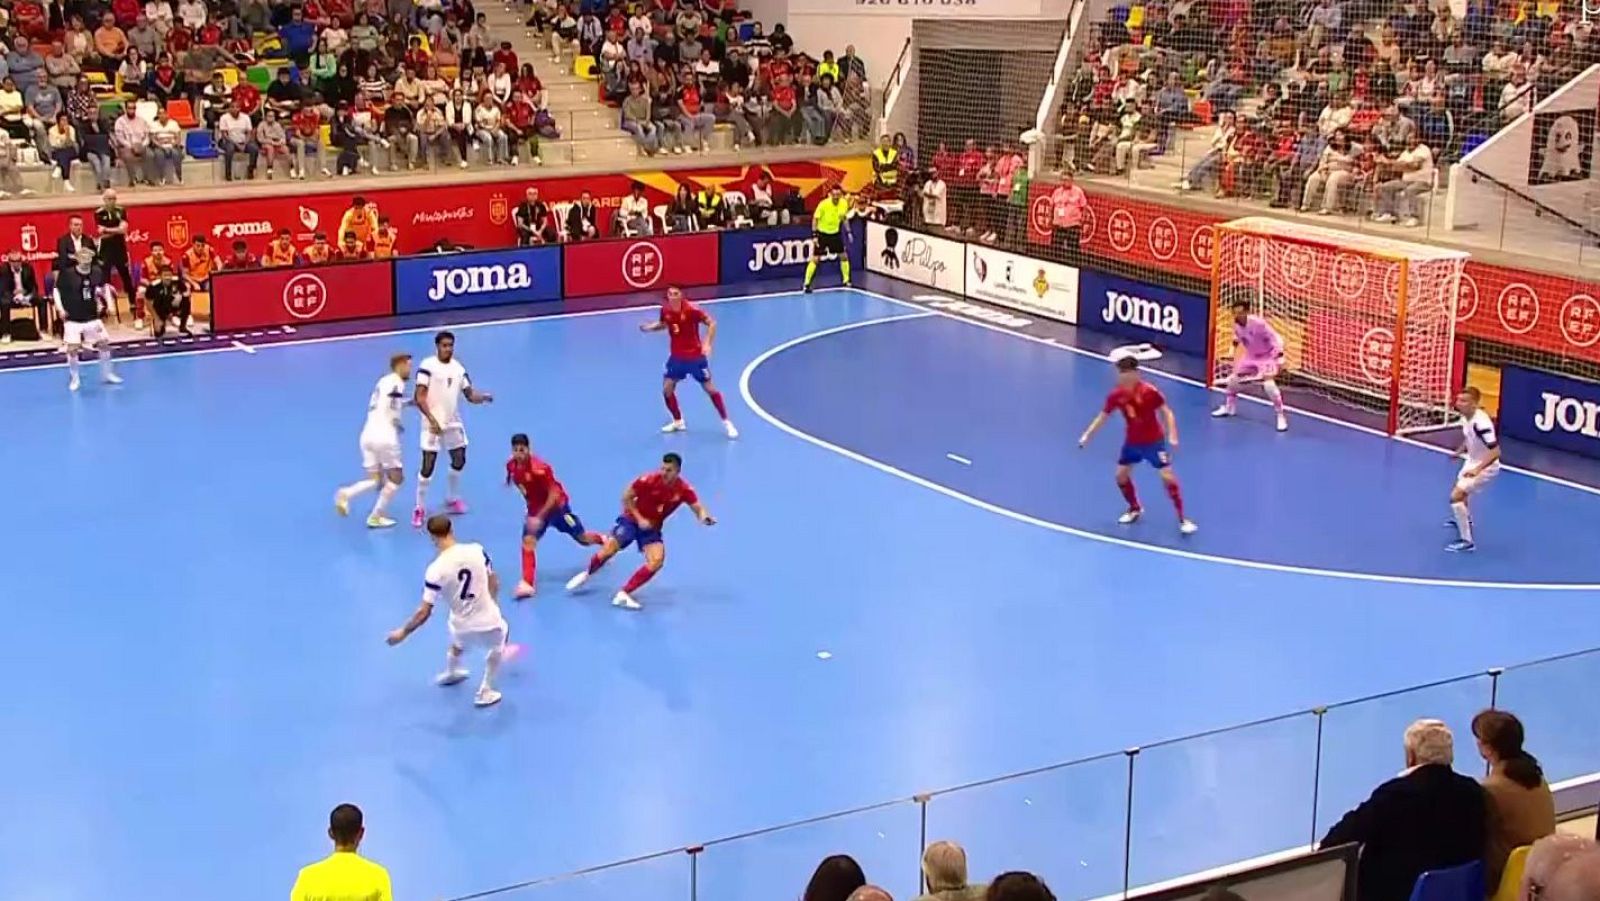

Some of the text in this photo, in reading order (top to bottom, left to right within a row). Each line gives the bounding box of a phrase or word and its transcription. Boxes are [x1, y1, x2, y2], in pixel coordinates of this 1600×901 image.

[428, 262, 531, 302] Joma
[1102, 291, 1182, 336] Joma
[458, 568, 475, 600] 2
